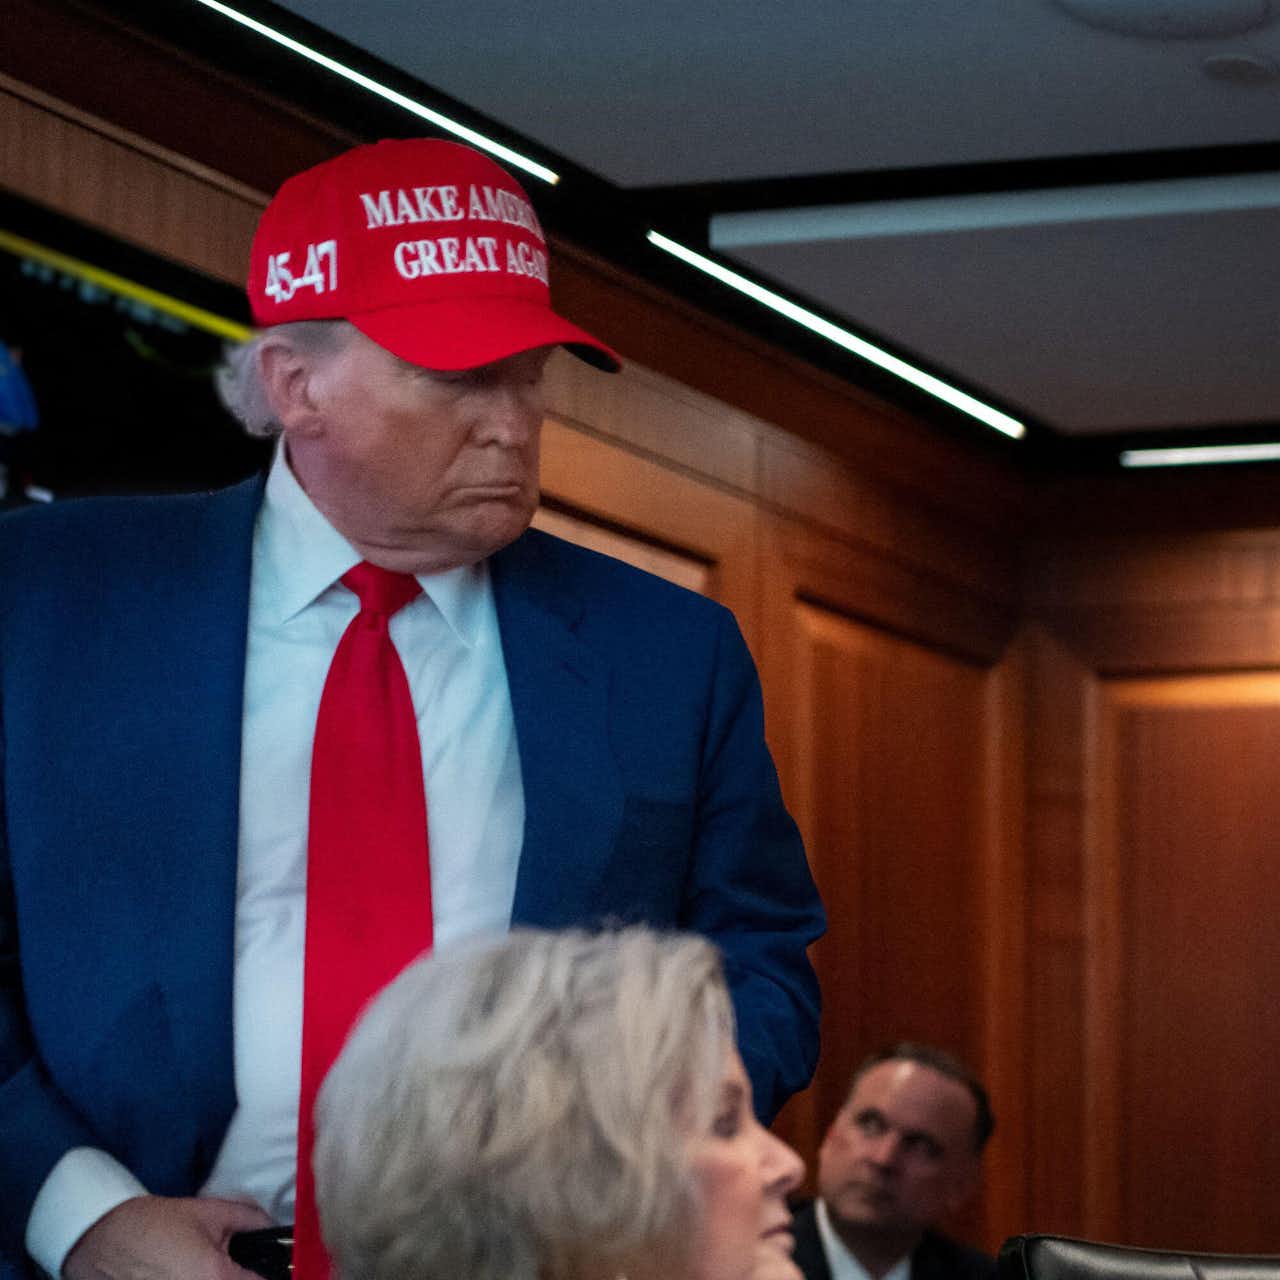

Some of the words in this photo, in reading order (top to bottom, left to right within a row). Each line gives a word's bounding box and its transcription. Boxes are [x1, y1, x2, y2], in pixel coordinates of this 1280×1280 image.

[360, 185, 464, 229] MAKE
[265, 239, 337, 303] 45-47
[394, 237, 500, 279] GREAT
